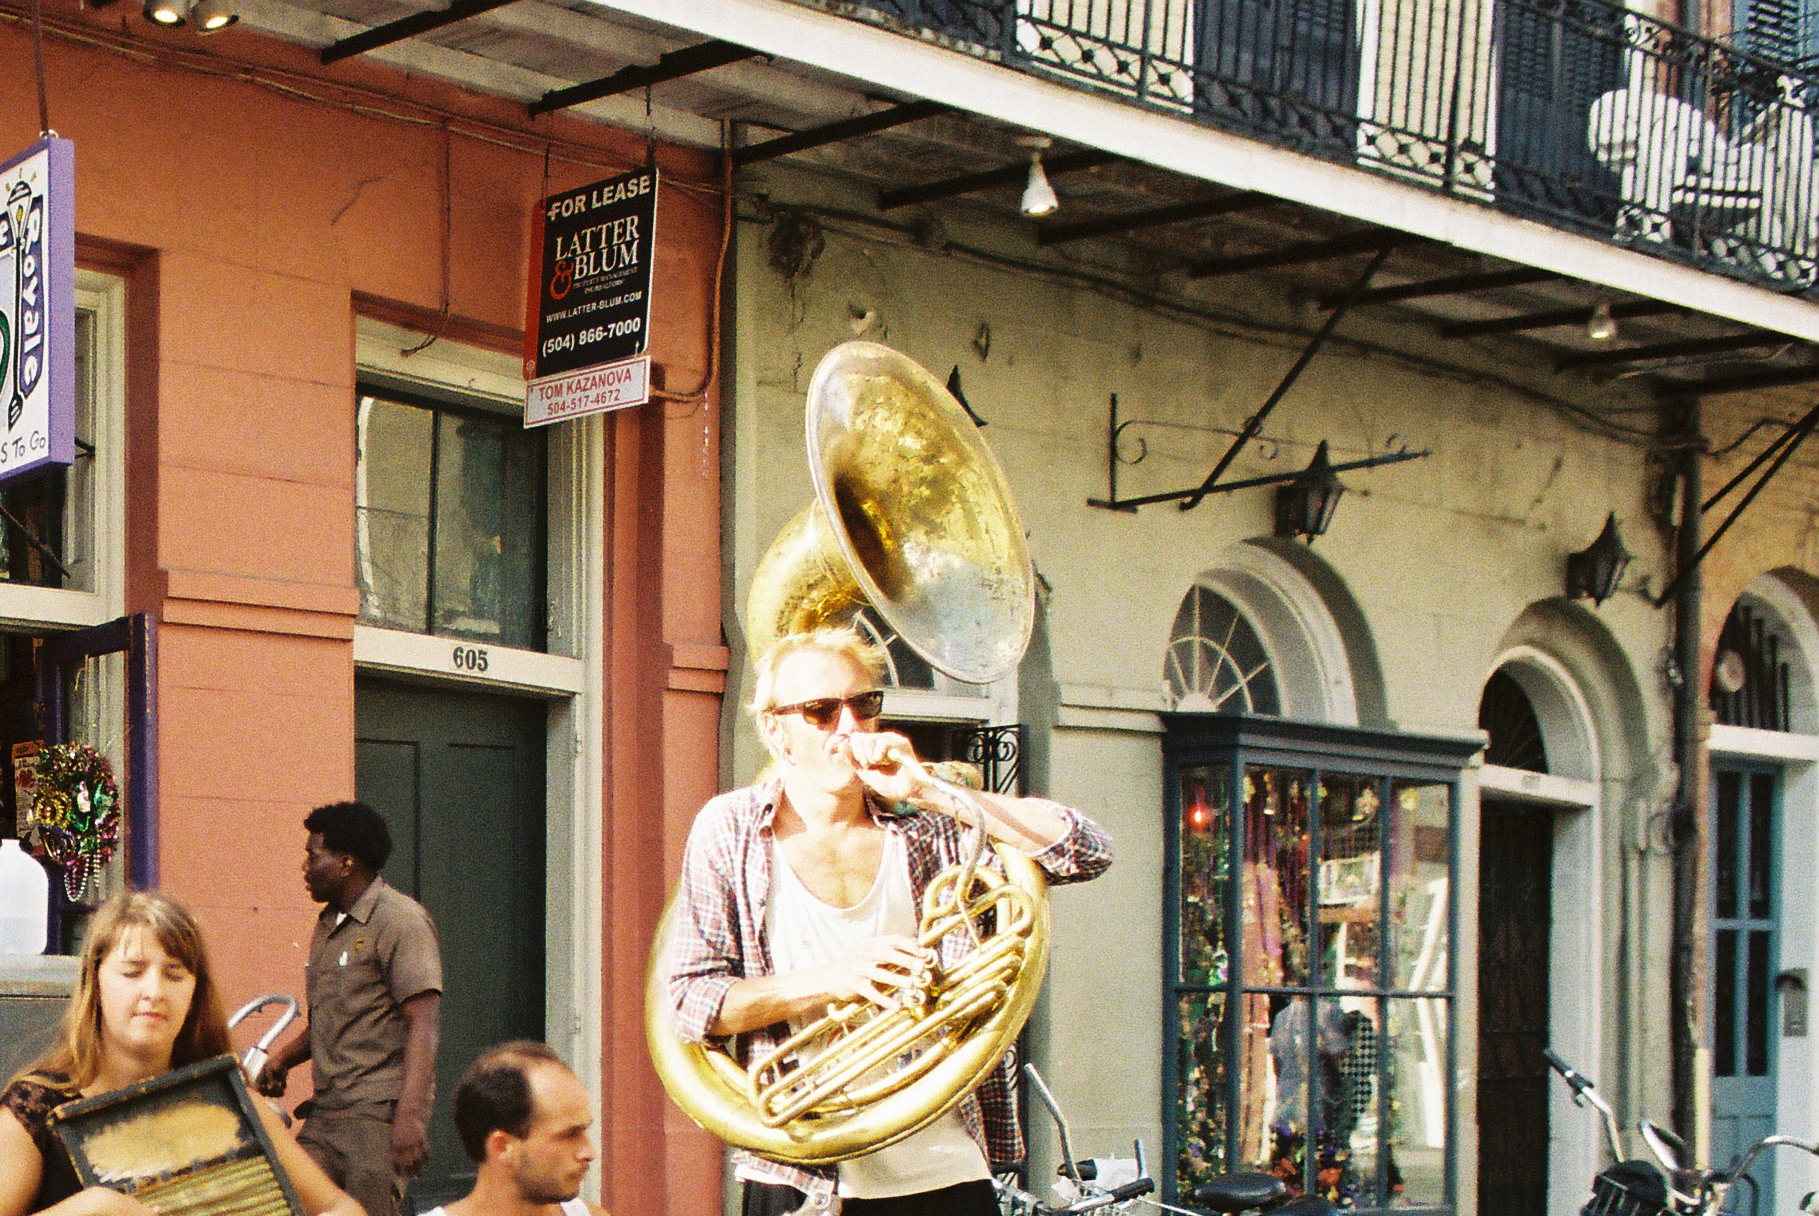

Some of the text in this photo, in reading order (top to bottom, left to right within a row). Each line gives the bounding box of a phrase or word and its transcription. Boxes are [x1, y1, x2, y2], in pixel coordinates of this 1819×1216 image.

[549, 175, 651, 221] FOR LEASE
[555, 214, 640, 261] LATTER
[573, 239, 640, 280] BLUM
[546, 291, 642, 323] WWW.LATTER-BLUM.COM
[543, 317, 641, 358] (504) 866-7000
[538, 367, 632, 402] TOM KAZANOVA
[547, 388, 621, 416] 504-517-4672
[12, 436, 26, 458] To
[29, 430, 46, 450] Go
[453, 646, 489, 672] 605
